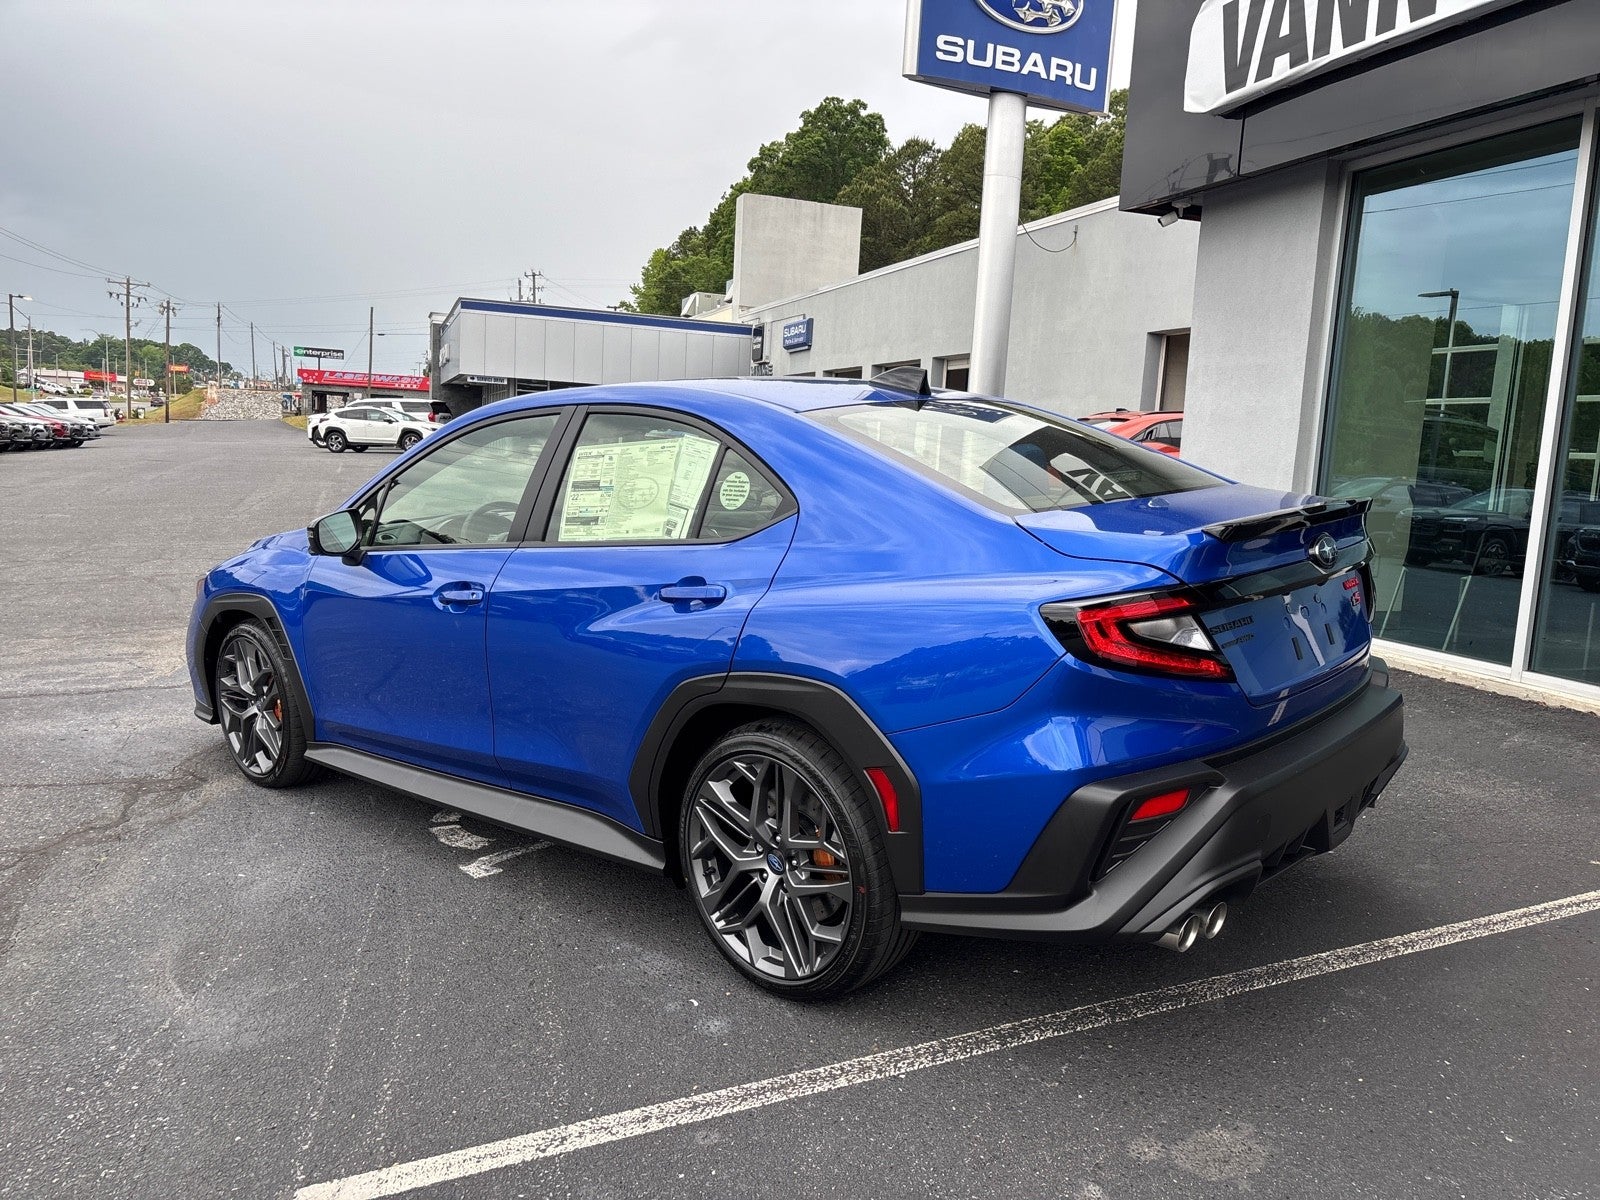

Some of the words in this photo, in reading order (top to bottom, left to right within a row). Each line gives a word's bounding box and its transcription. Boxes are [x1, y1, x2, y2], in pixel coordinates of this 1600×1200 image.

[935, 34, 1097, 91] SUBARU
[784, 325, 806, 337] SUBARU
[295, 347, 344, 358] enterprise
[1209, 616, 1254, 635] SUBARU
